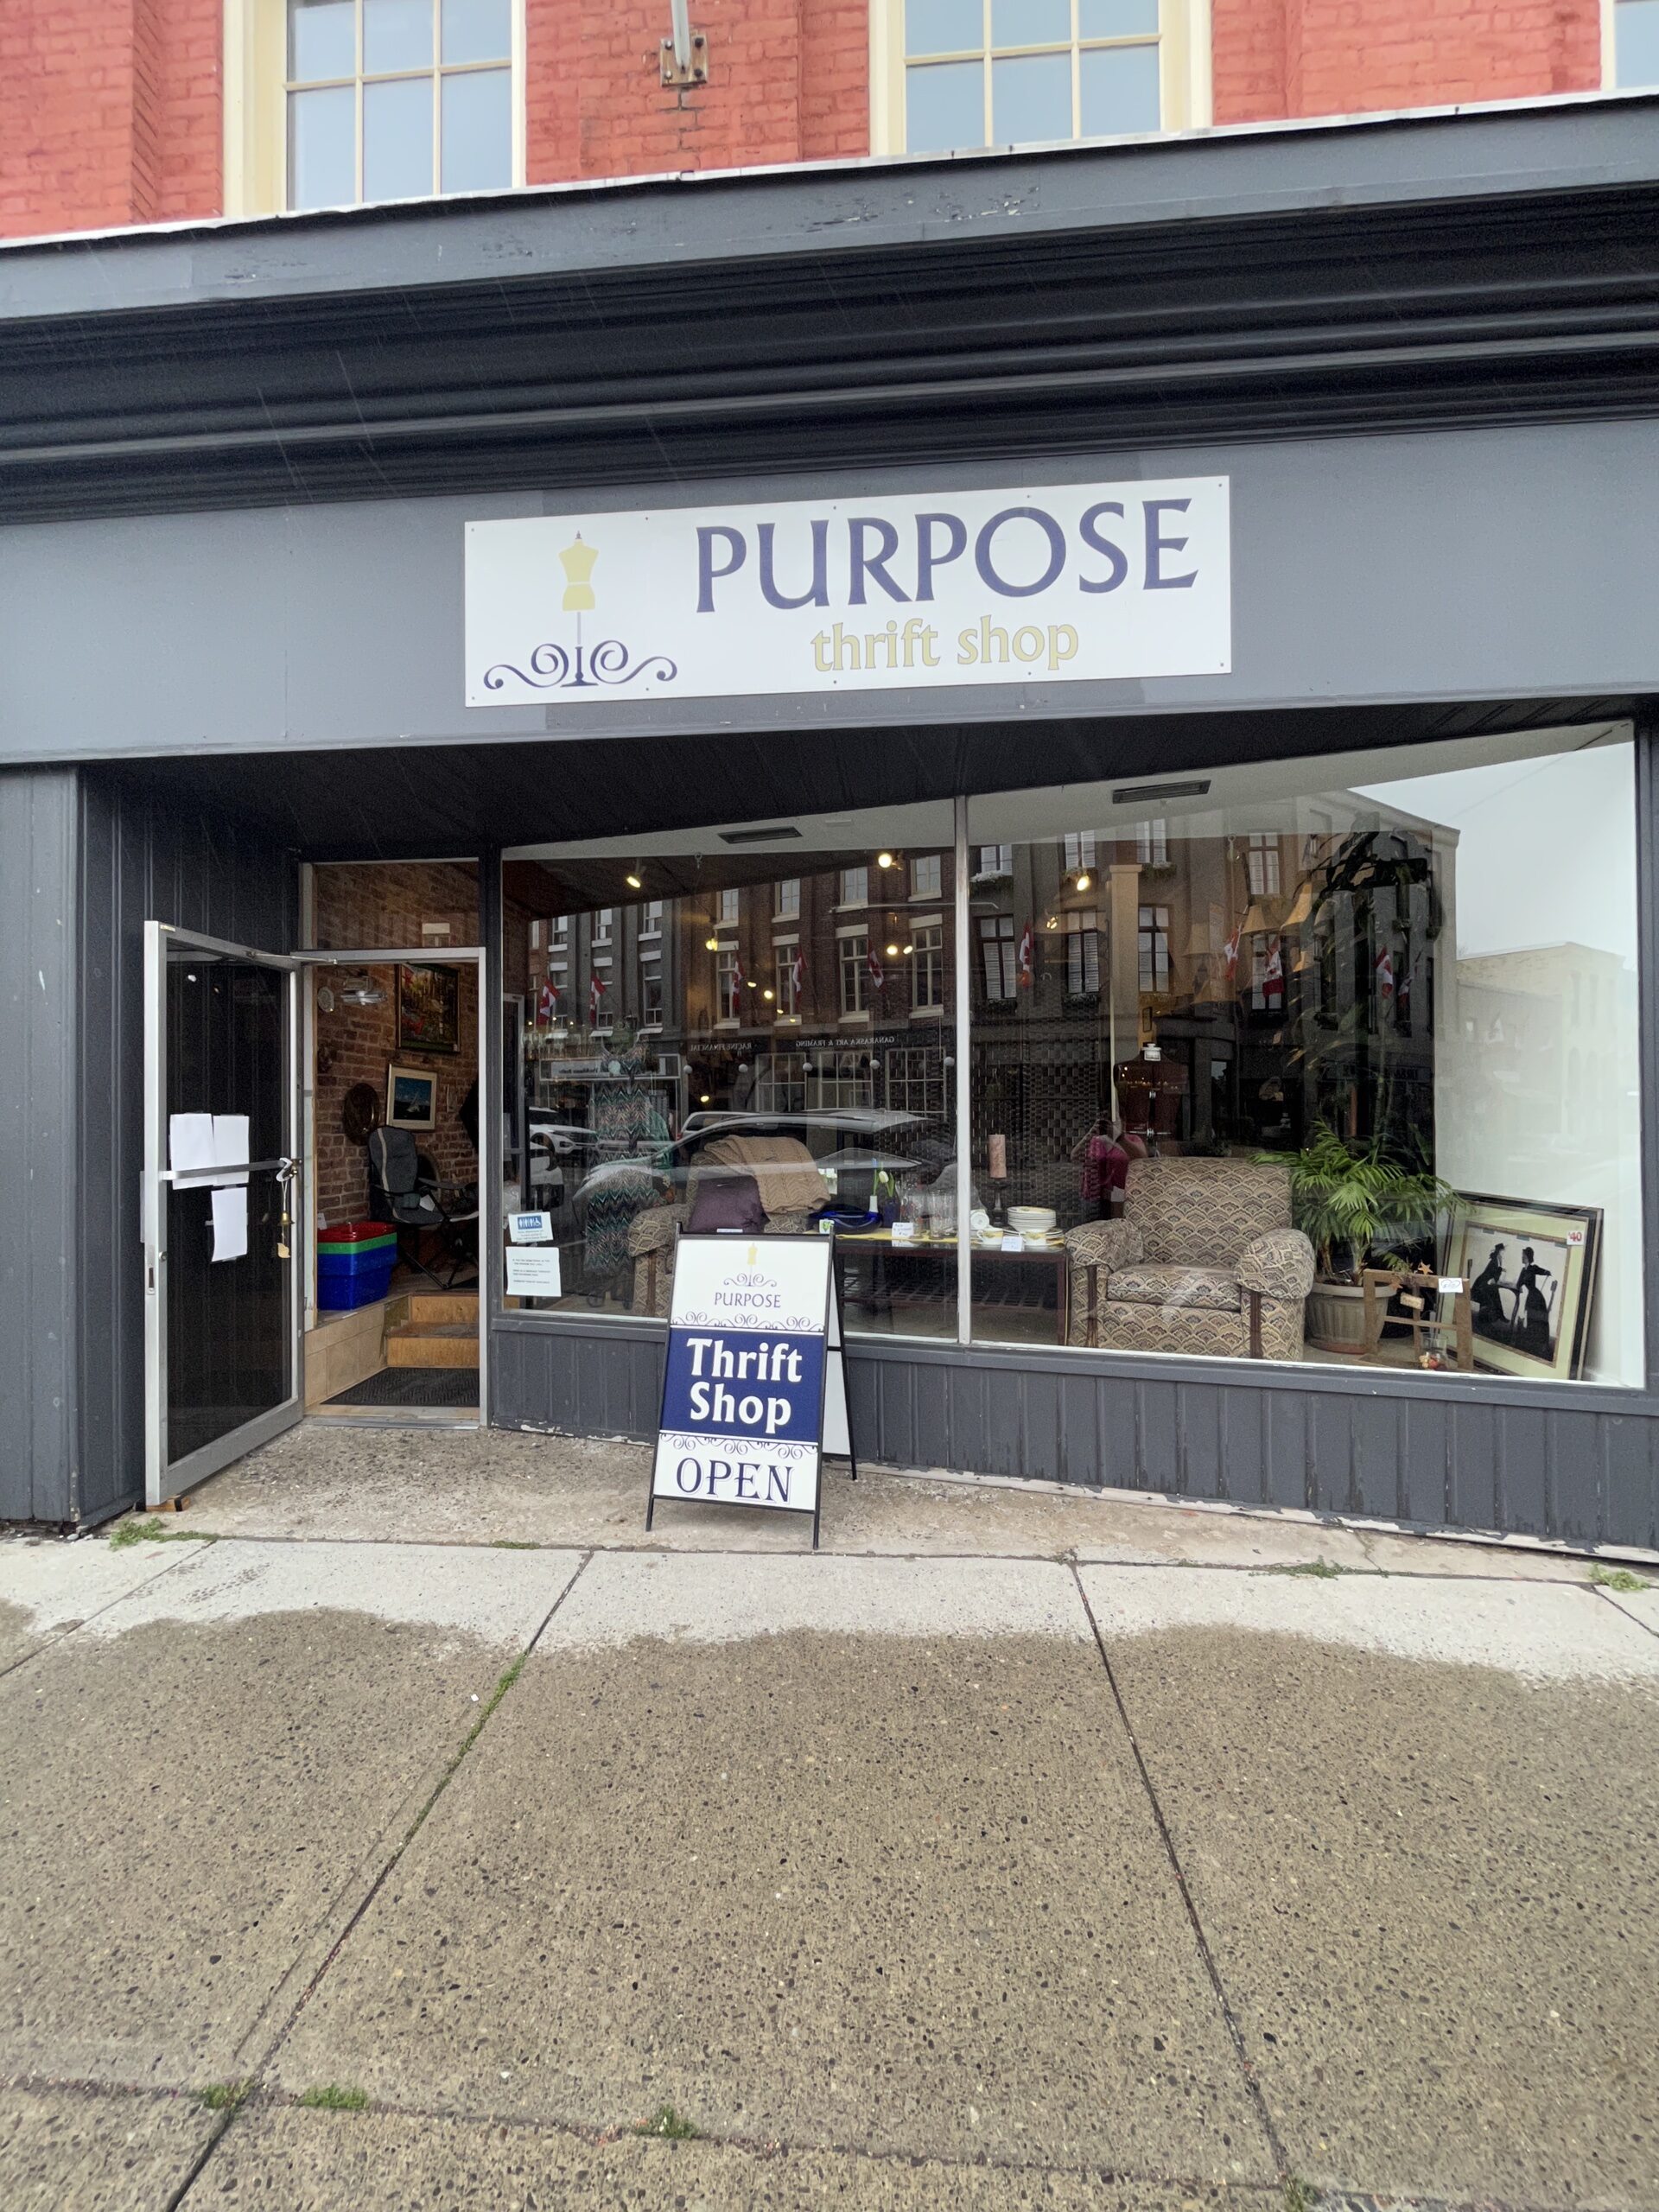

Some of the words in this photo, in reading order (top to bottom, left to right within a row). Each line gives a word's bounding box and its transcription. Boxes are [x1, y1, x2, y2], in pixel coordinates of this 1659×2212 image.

[696, 498, 1199, 613] PURPOSE
[810, 618, 941, 672] thrift
[957, 614, 1080, 671] shop
[714, 1292, 781, 1308] PURPOSE
[686, 1338, 803, 1382] Thrift
[690, 1382, 791, 1434] Shop
[677, 1458, 793, 1503] OPEN
